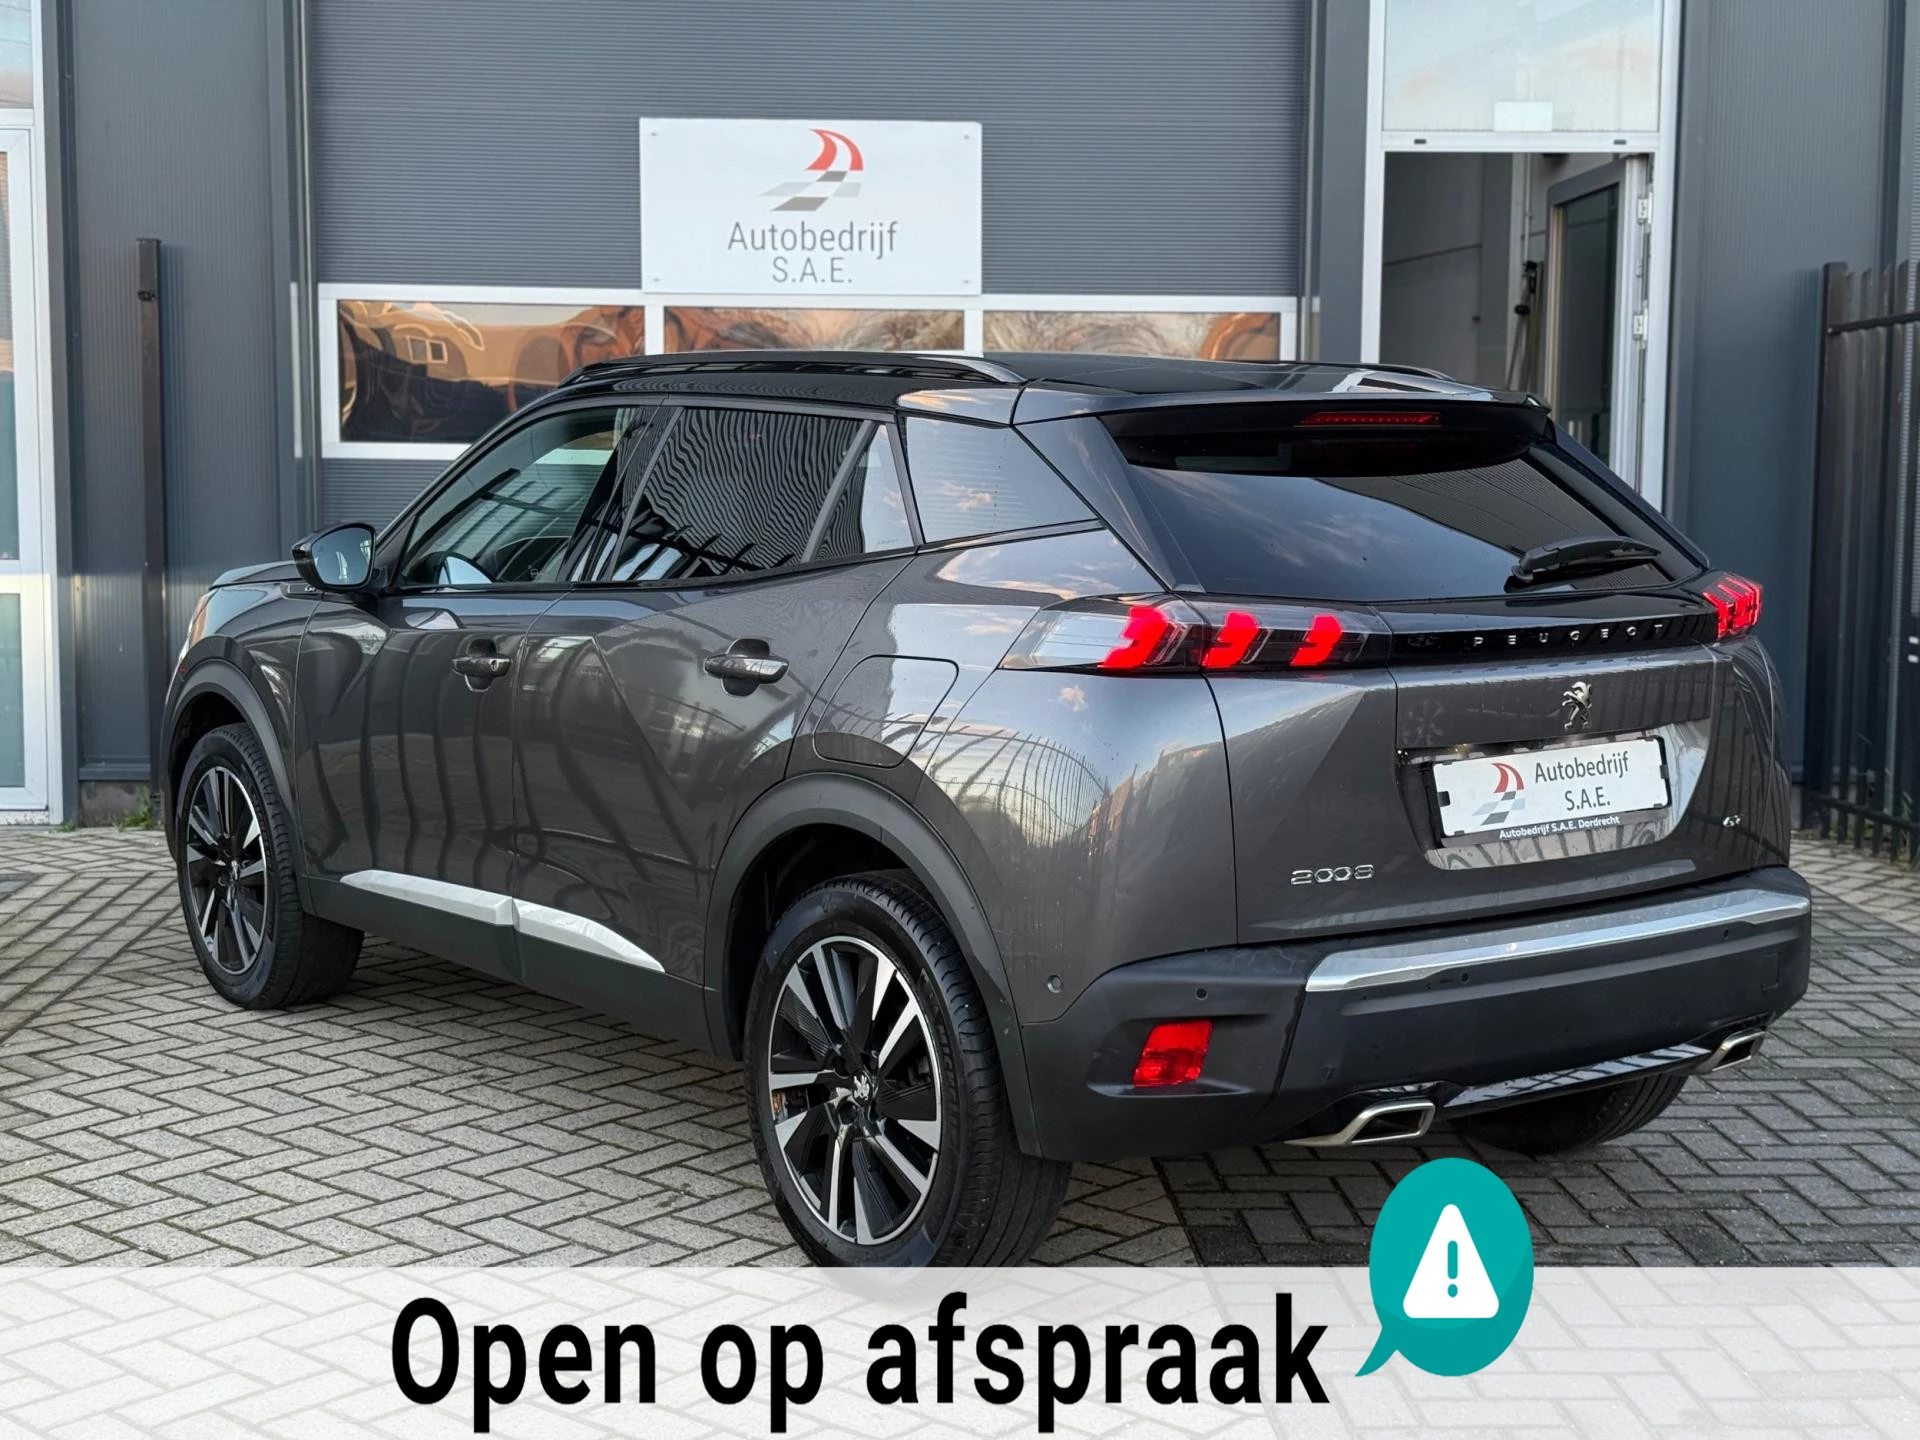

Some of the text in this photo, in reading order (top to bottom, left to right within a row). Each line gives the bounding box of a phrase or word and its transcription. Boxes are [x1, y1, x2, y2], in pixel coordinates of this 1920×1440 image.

[727, 220, 898, 260] Autobedrijf
[772, 256, 852, 283] S.A.E.
[1472, 623, 1664, 646] PEUGEOT
[1534, 750, 1629, 784] Autobedrijf
[1564, 786, 1611, 812] S.A.E.
[1499, 815, 1620, 840] Autobedrijf S.A.E. Dordrecht
[1290, 864, 1374, 885] 2008
